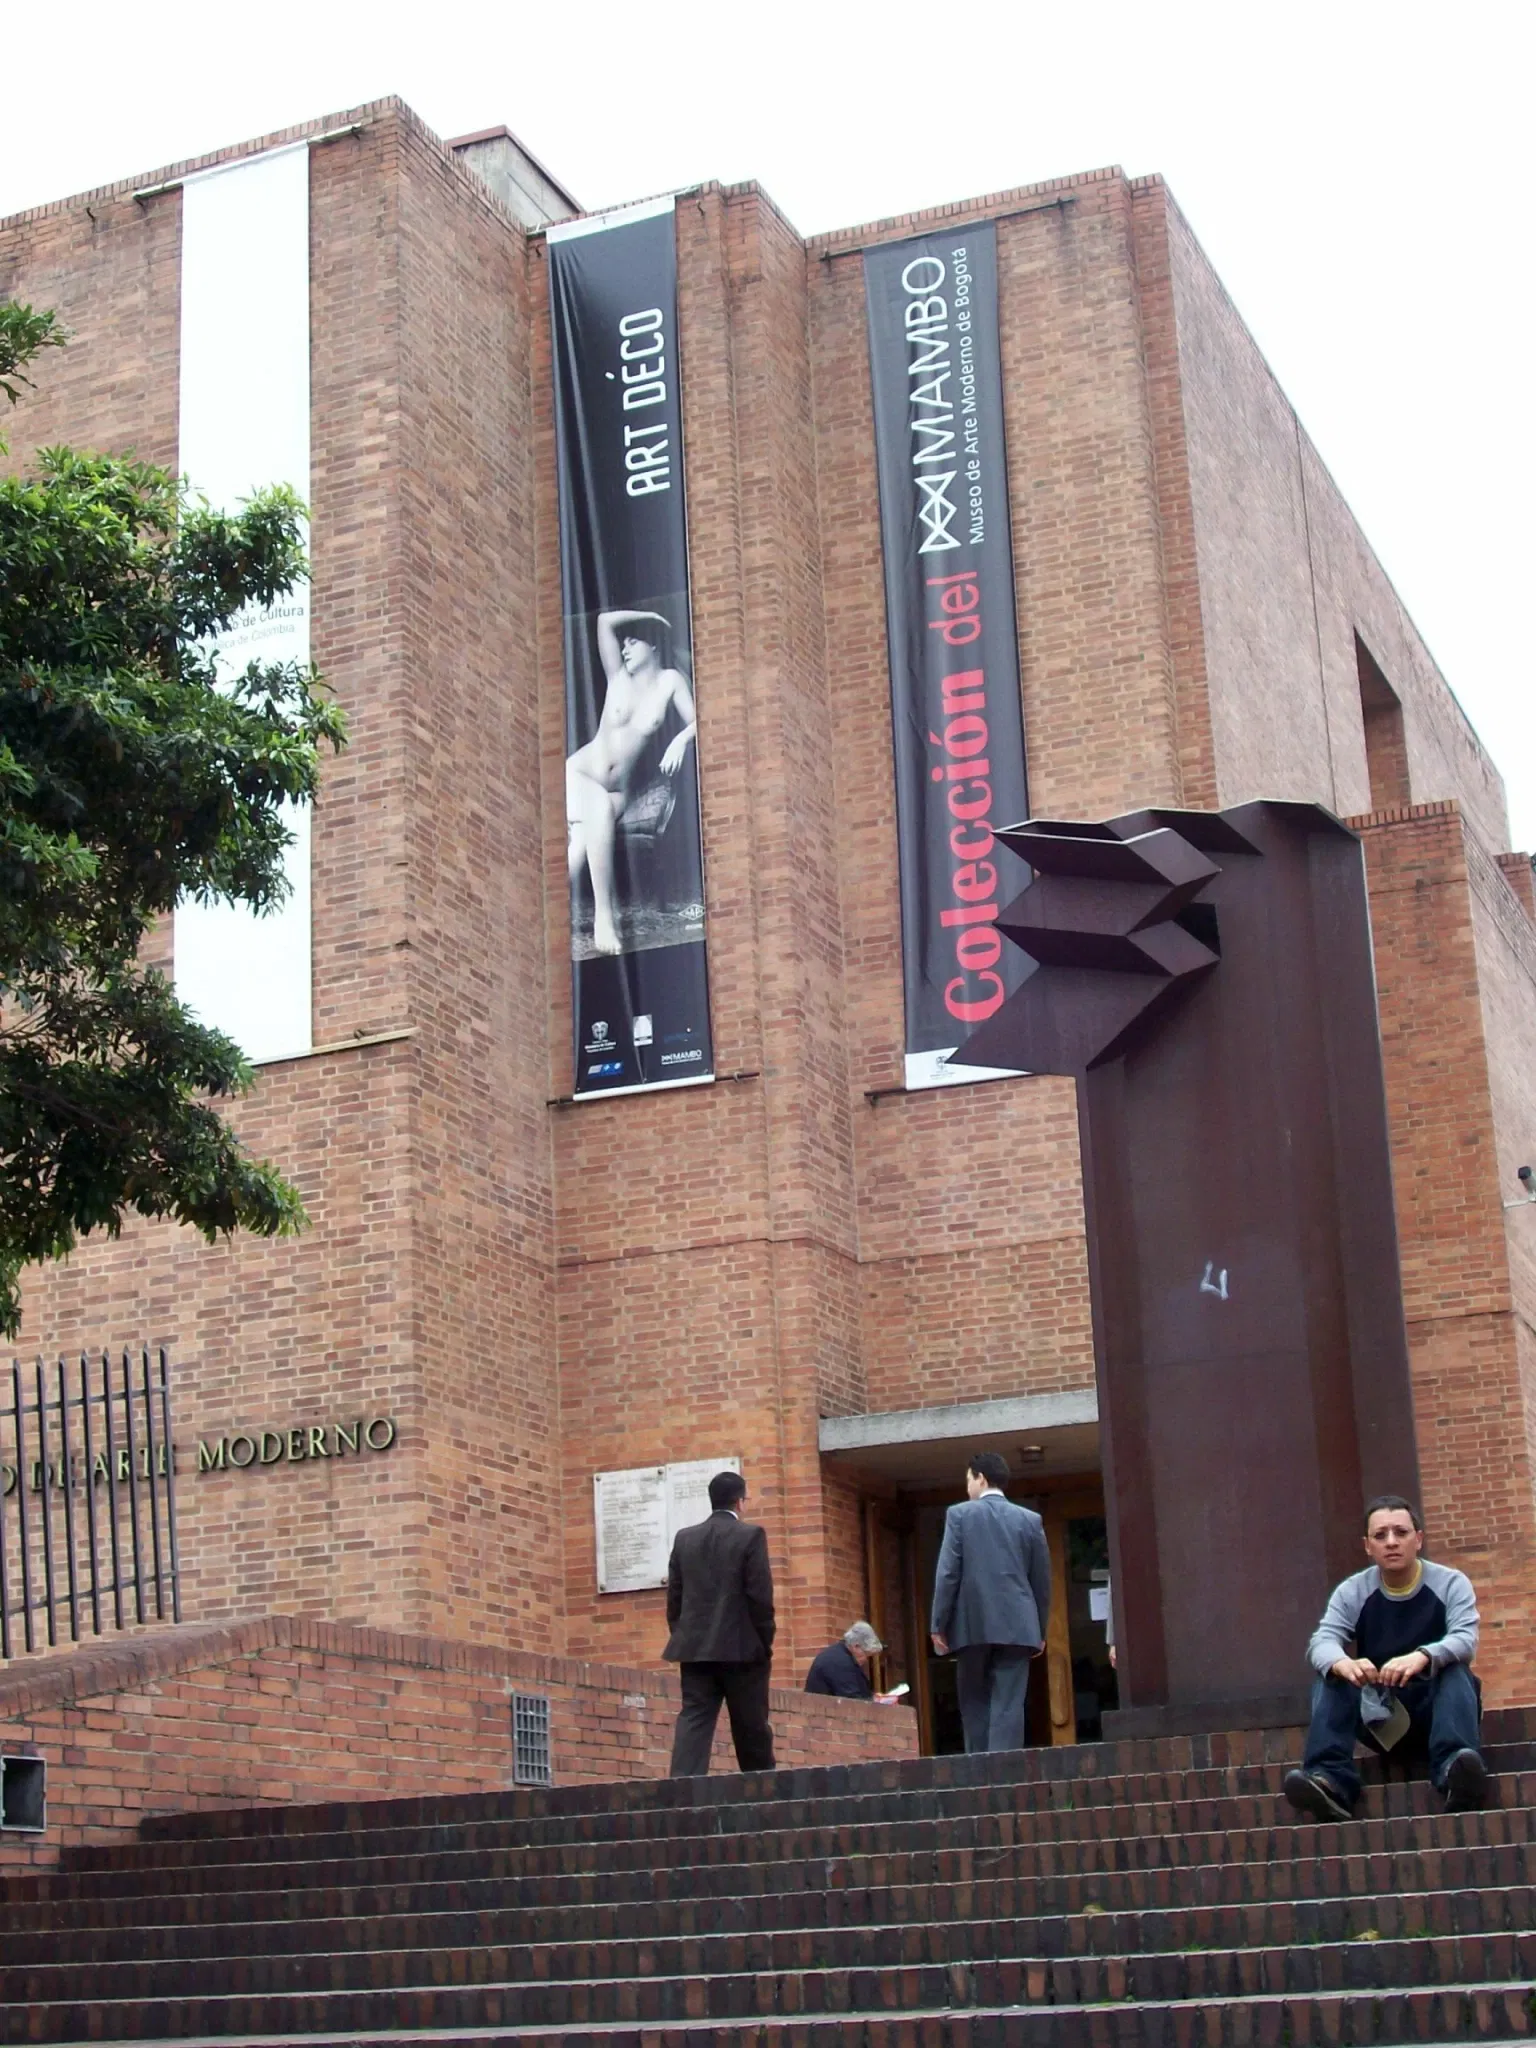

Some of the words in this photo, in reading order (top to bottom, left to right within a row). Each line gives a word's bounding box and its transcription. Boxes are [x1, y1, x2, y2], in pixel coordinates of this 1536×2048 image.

[951, 247, 973, 308] Bogotá
[956, 311, 972, 331] de
[902, 256, 956, 465] MAMBO
[958, 337, 977, 414] Moderno
[624, 423, 671, 497] ART
[963, 417, 979, 454] Arte
[964, 459, 981, 481] de
[969, 486, 985, 544] Museo
[242, 616, 257, 628] de
[259, 606, 304, 624] Cultura
[926, 571, 982, 646] del
[929, 668, 1005, 1023] Colección
[199, 1418, 395, 1472] MODERNO
